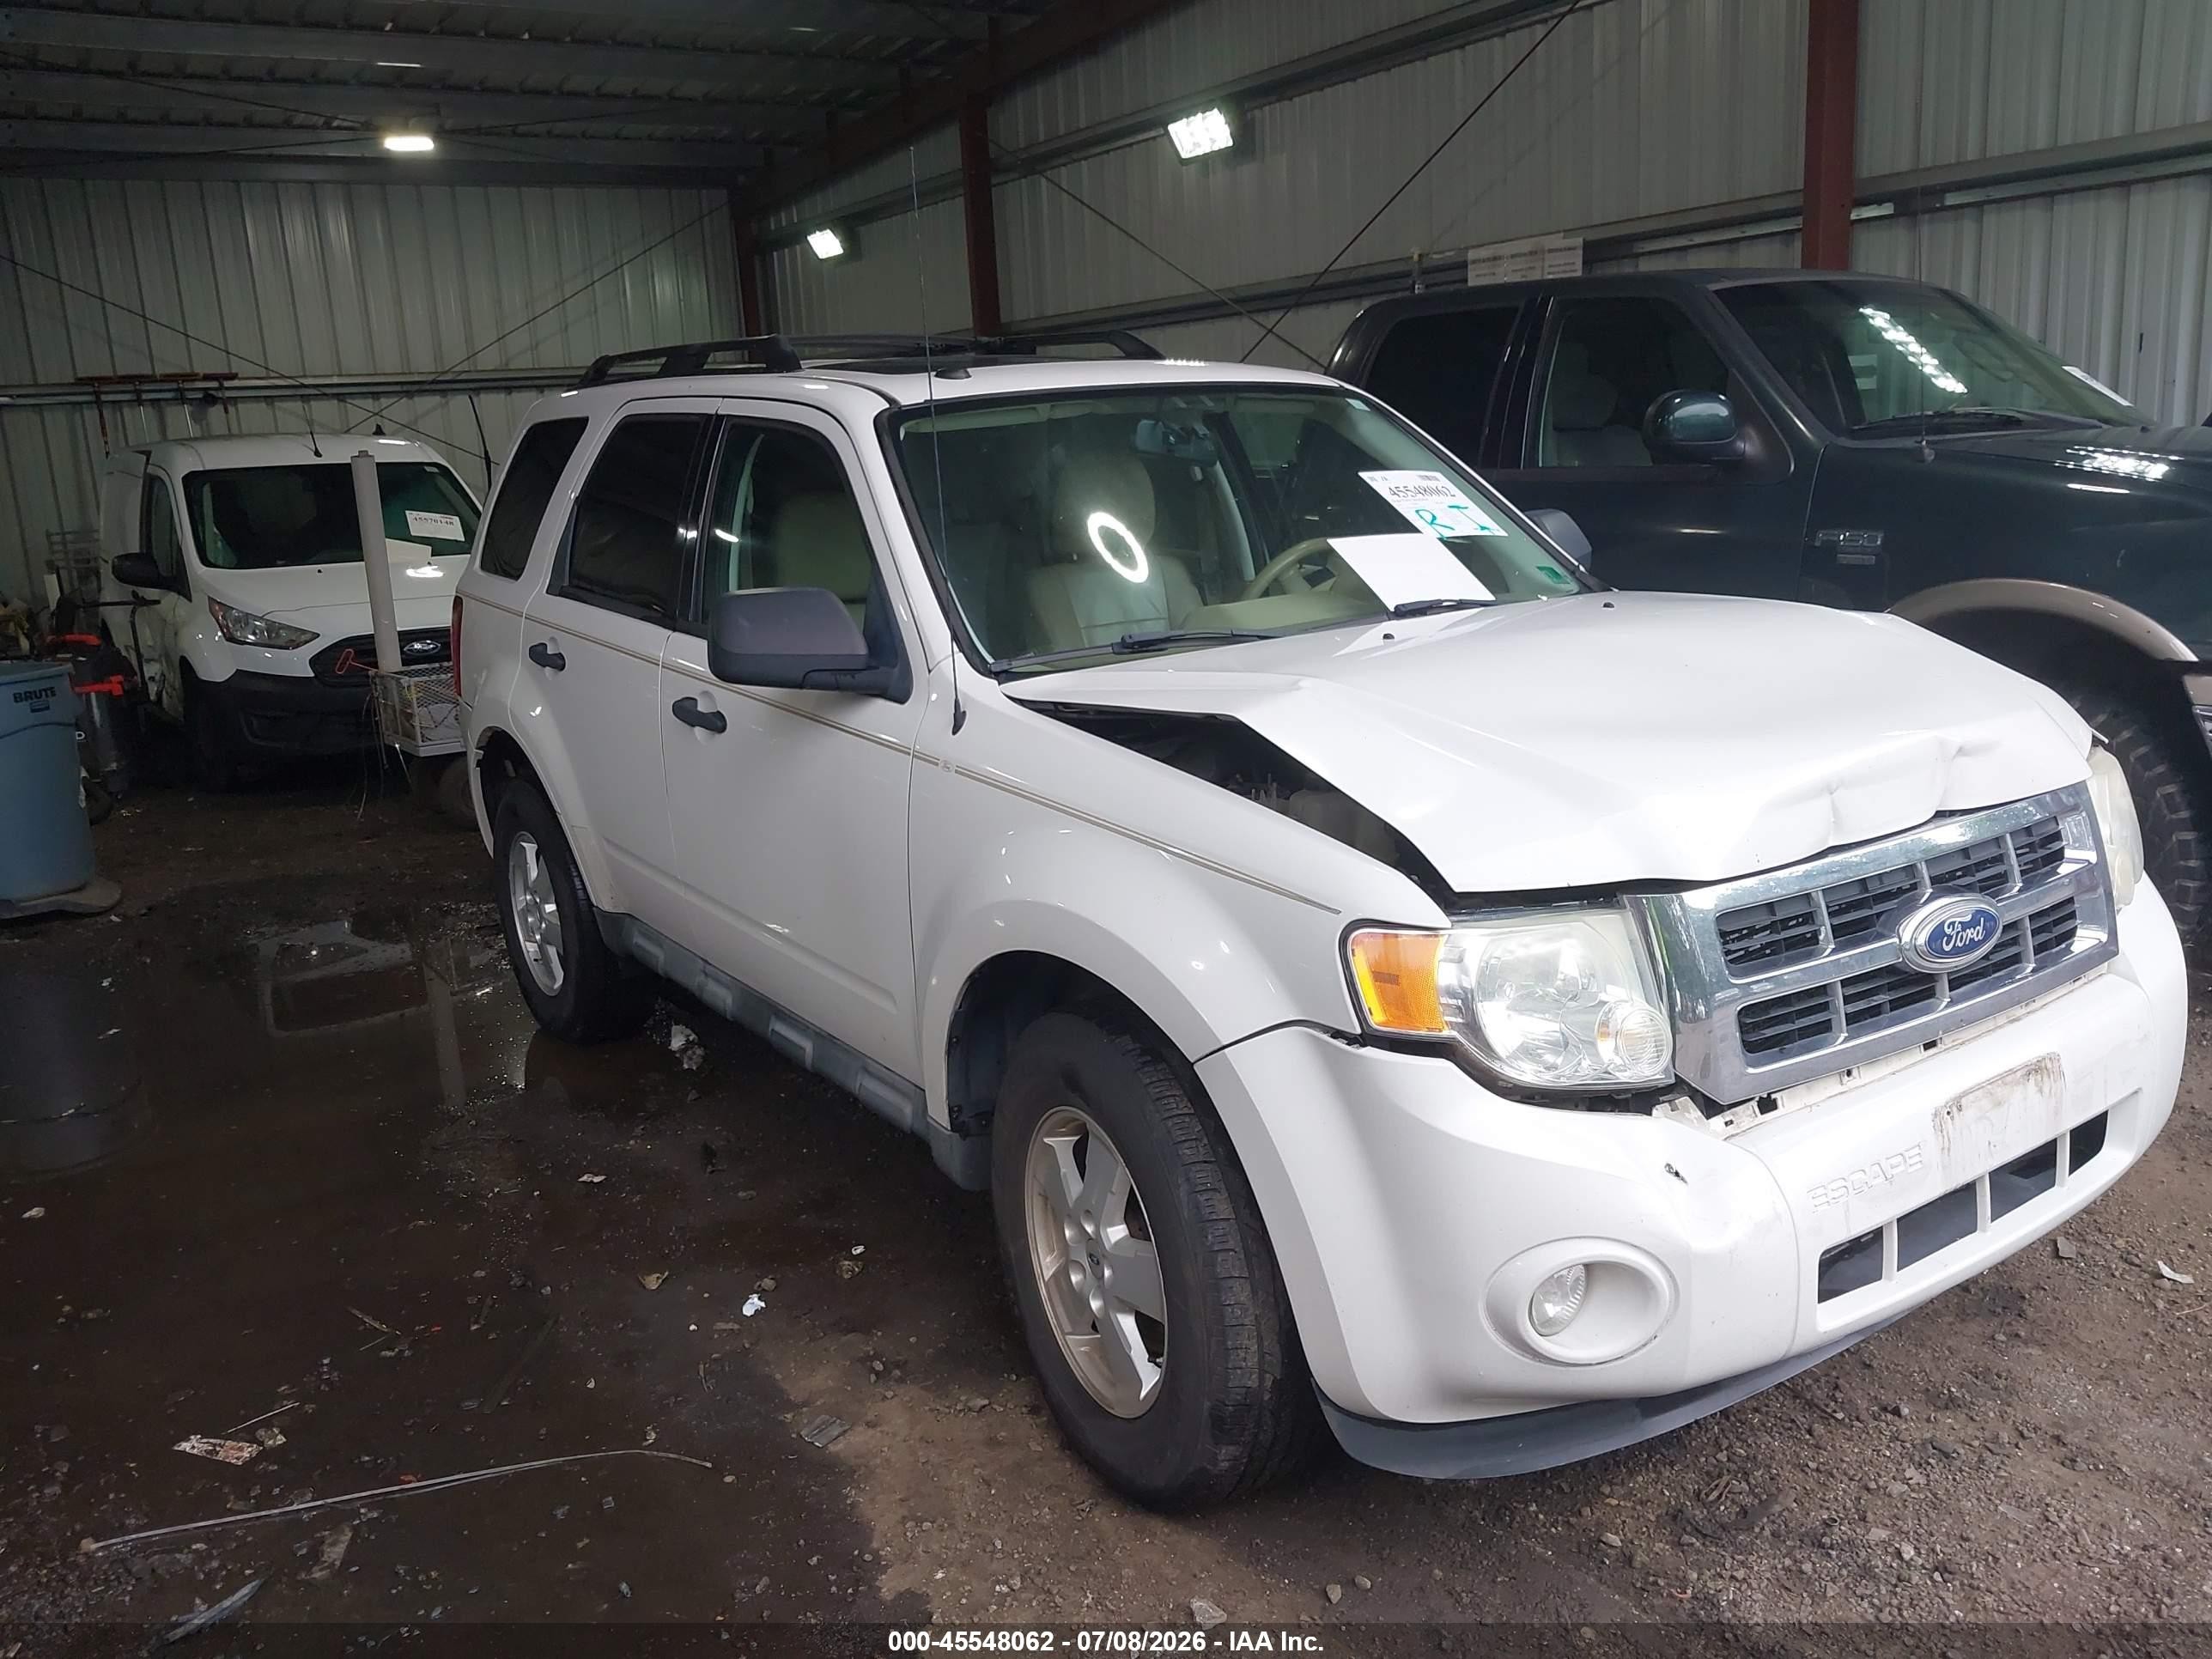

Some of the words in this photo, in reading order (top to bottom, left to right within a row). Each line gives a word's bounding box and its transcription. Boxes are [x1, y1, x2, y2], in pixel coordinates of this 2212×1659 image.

[1389, 485, 1456, 499] 45548062
[13, 687, 57, 703] BRUTE
[1942, 913, 1987, 952] Ford
[1806, 1141, 1923, 1213] ESCAPE
